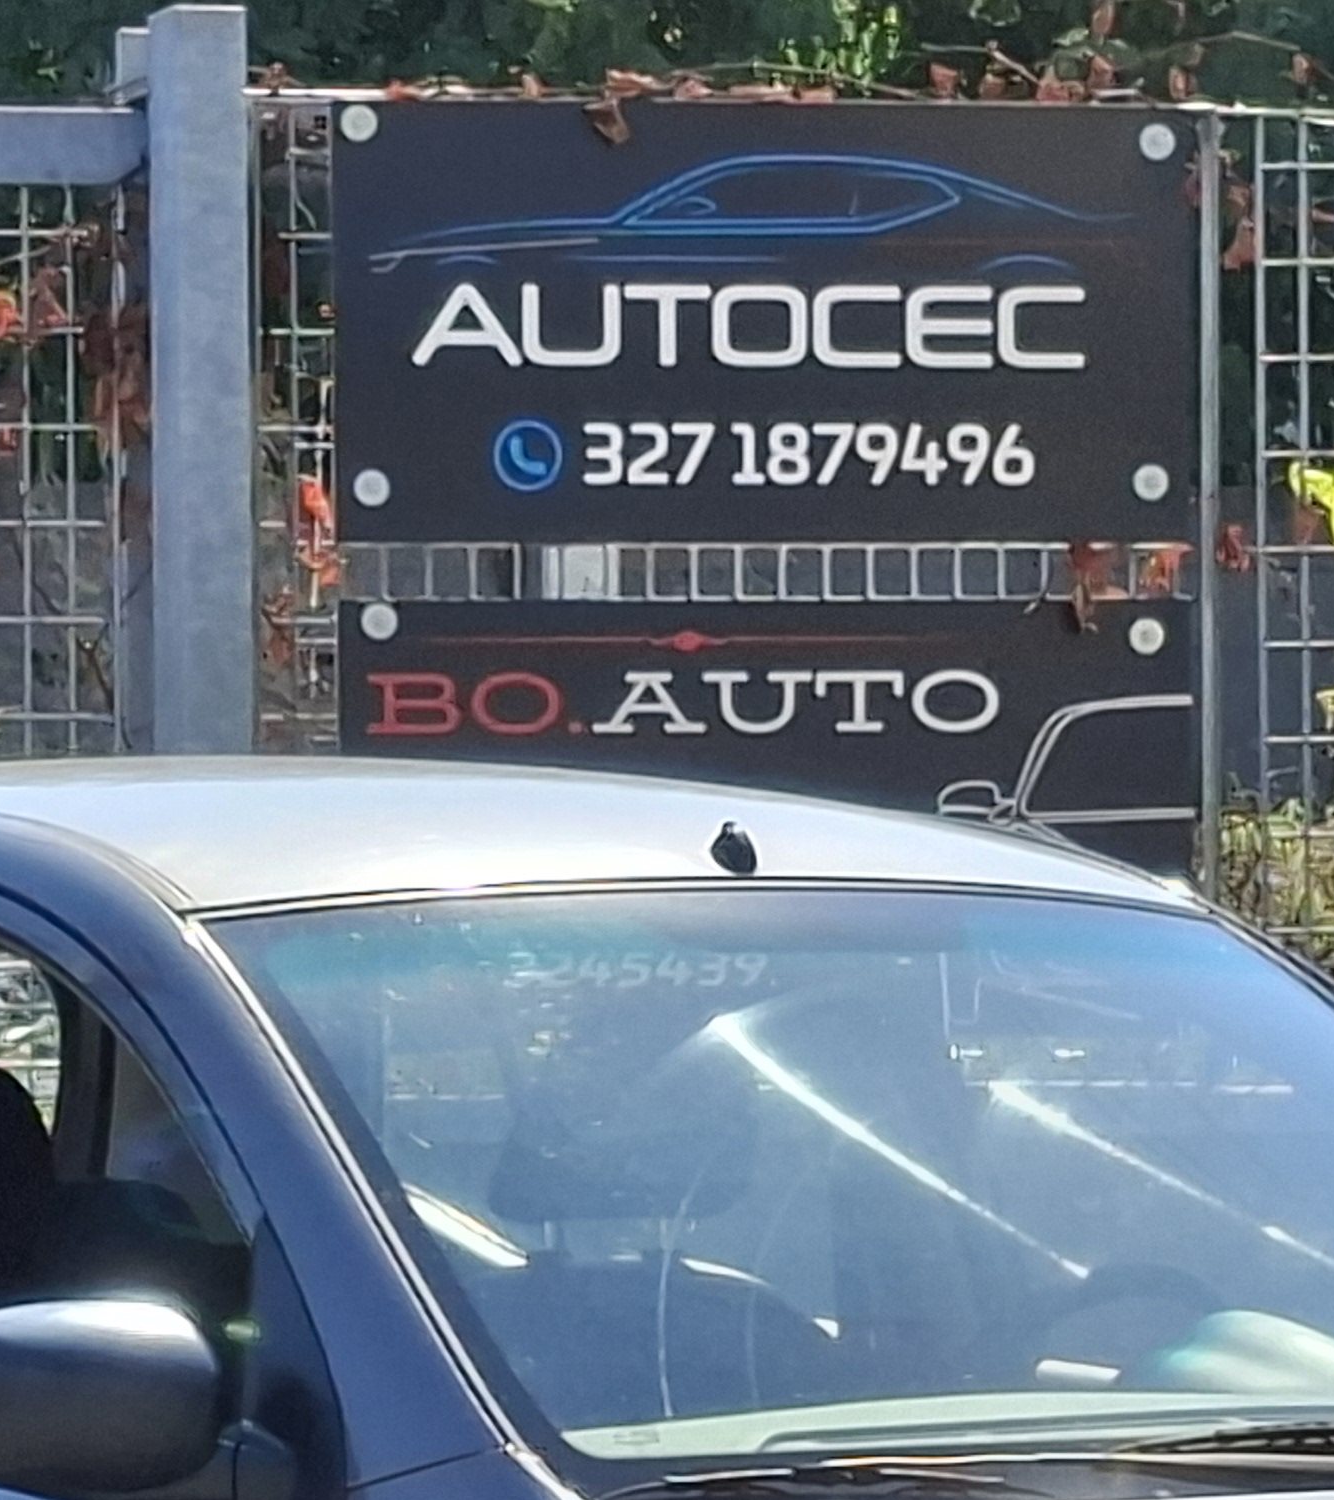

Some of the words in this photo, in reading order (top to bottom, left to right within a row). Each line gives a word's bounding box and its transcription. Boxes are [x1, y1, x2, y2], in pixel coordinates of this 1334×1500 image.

[411, 283, 1087, 370] AUTOCEC
[583, 422, 717, 487] 327
[731, 421, 1037, 488] 1879496
